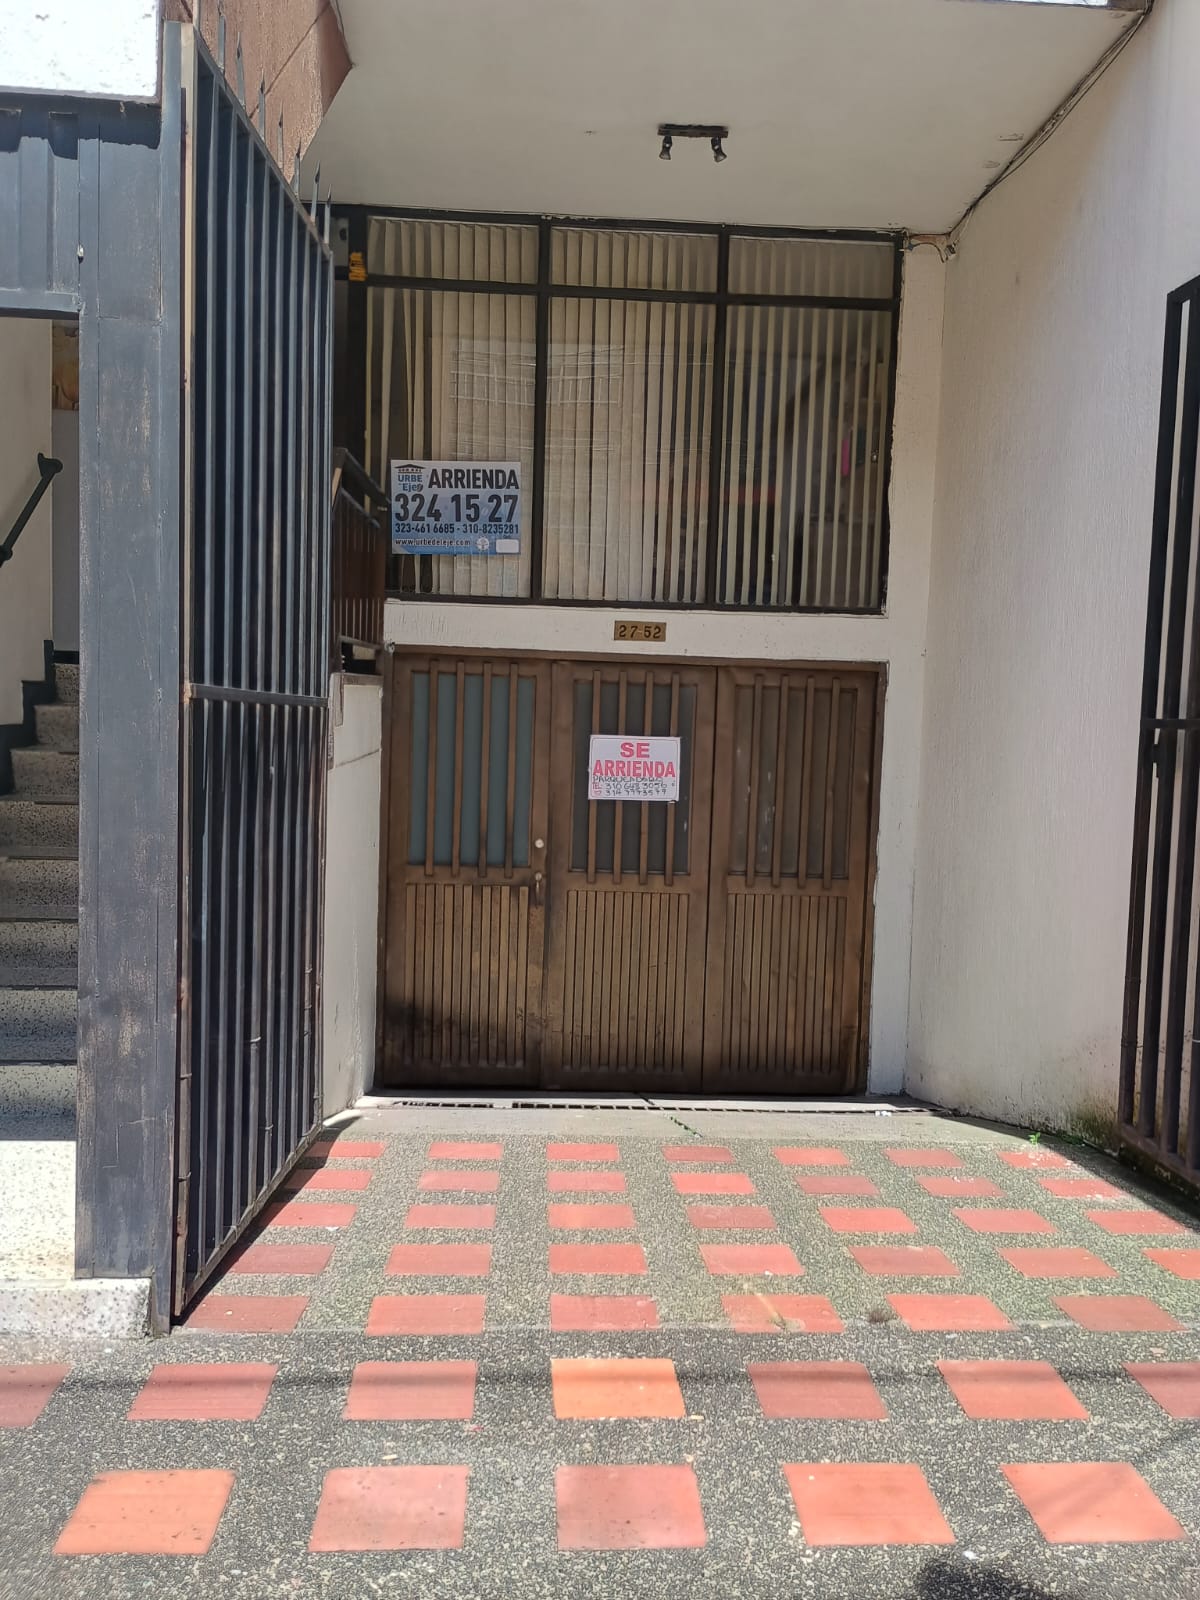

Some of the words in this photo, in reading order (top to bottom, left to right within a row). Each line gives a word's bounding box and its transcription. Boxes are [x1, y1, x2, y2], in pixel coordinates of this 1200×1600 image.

[428, 469, 520, 490] ARRIENDA
[395, 493, 442, 522] 324
[450, 494, 480, 522] 15
[487, 494, 519, 523] 27
[395, 523, 430, 533] 323-461
[433, 523, 455, 533] 6685
[462, 524, 519, 534] 310-8235281
[619, 625, 661, 639] 27-52
[620, 742, 650, 758] SE
[592, 760, 676, 777] ARRIENDA
